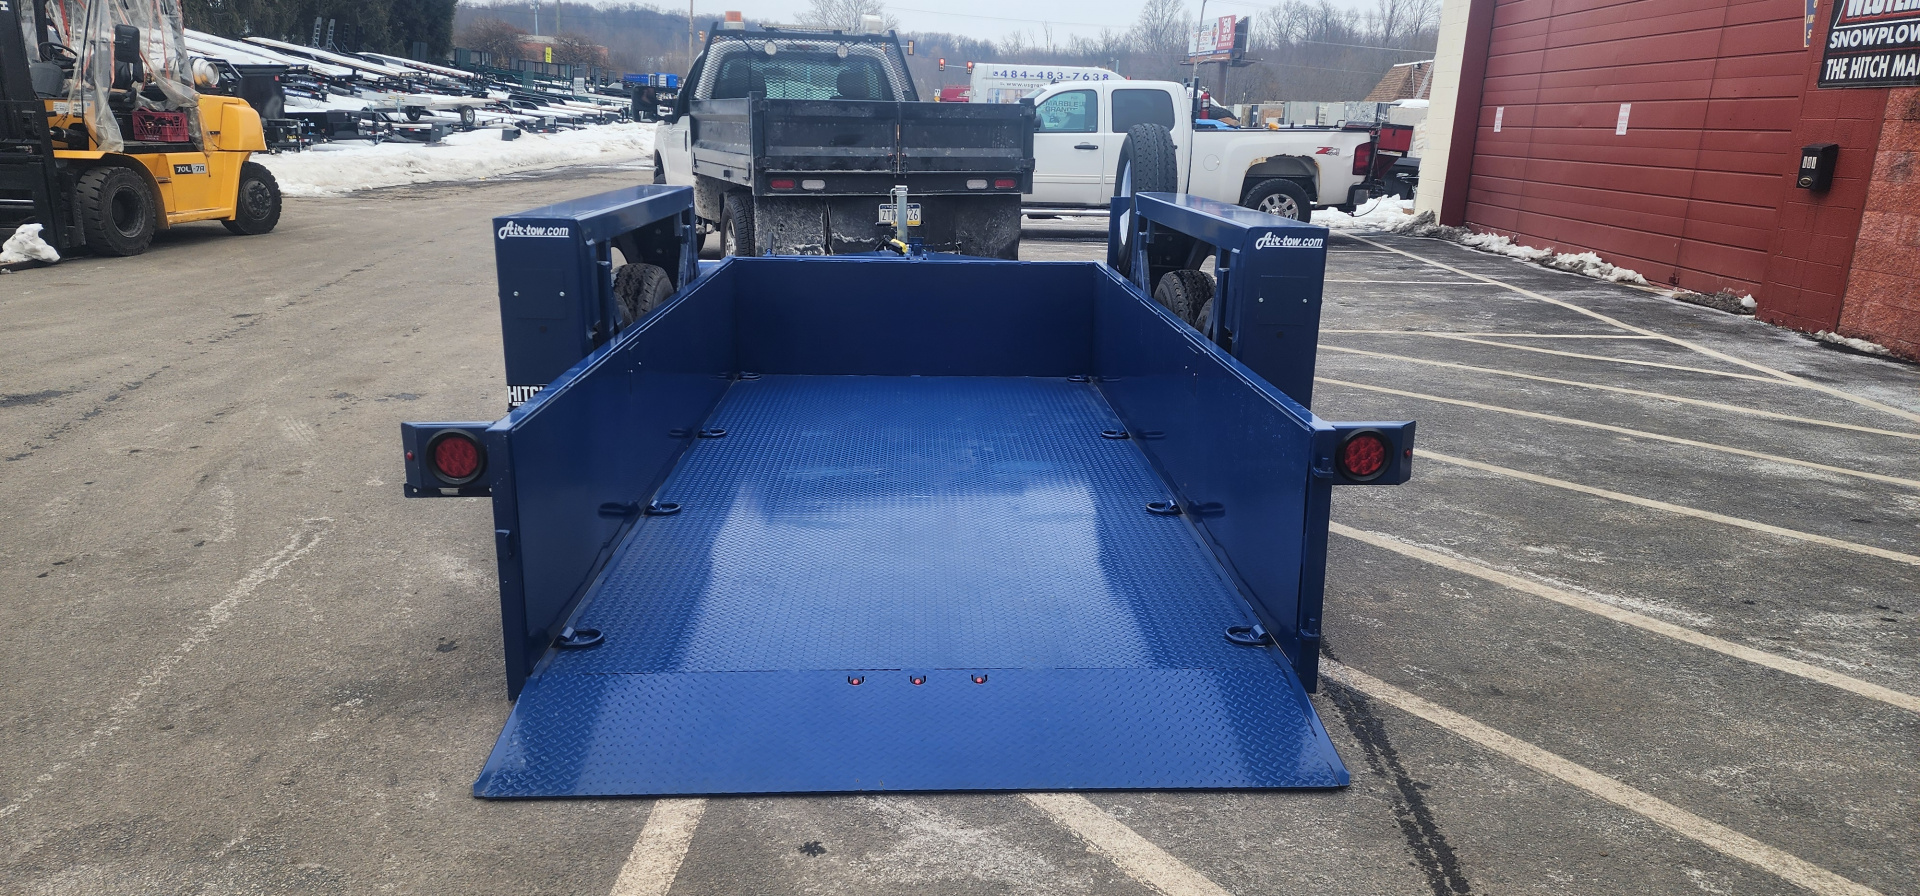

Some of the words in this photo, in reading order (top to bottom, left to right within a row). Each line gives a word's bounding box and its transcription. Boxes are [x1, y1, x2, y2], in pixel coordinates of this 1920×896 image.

[1000, 70, 1109, 81] 484-483-7638
[1825, 57, 1849, 80] THE
[1849, 55, 1890, 79] HITCH
[1890, 53, 1920, 77] MA
[498, 220, 569, 240] Air-tow.com
[1255, 231, 1323, 250] Air-tow.com
[507, 385, 543, 403] HITC
